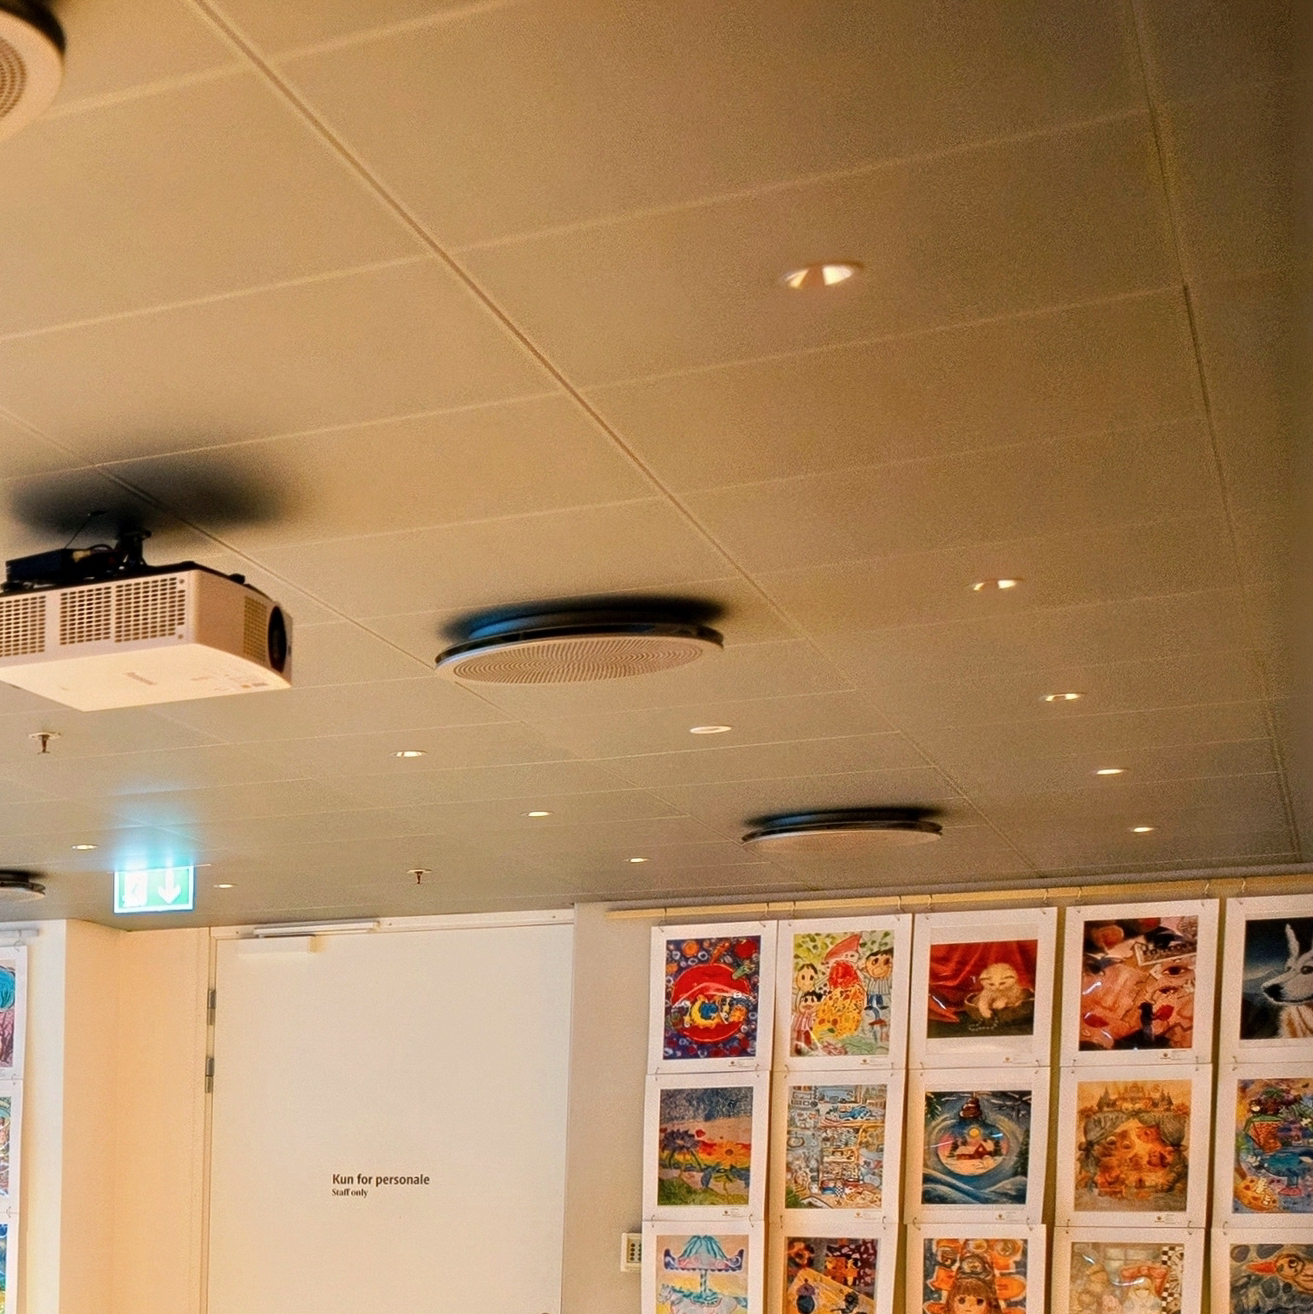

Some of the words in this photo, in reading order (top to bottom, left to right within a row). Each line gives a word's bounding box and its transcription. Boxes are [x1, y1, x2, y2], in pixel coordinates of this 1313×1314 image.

[332, 1173, 354, 1185] Kun
[357, 1173, 373, 1185] for
[375, 1173, 430, 1187] personale
[331, 1188, 350, 1197] Staff
[351, 1188, 368, 1198] only
